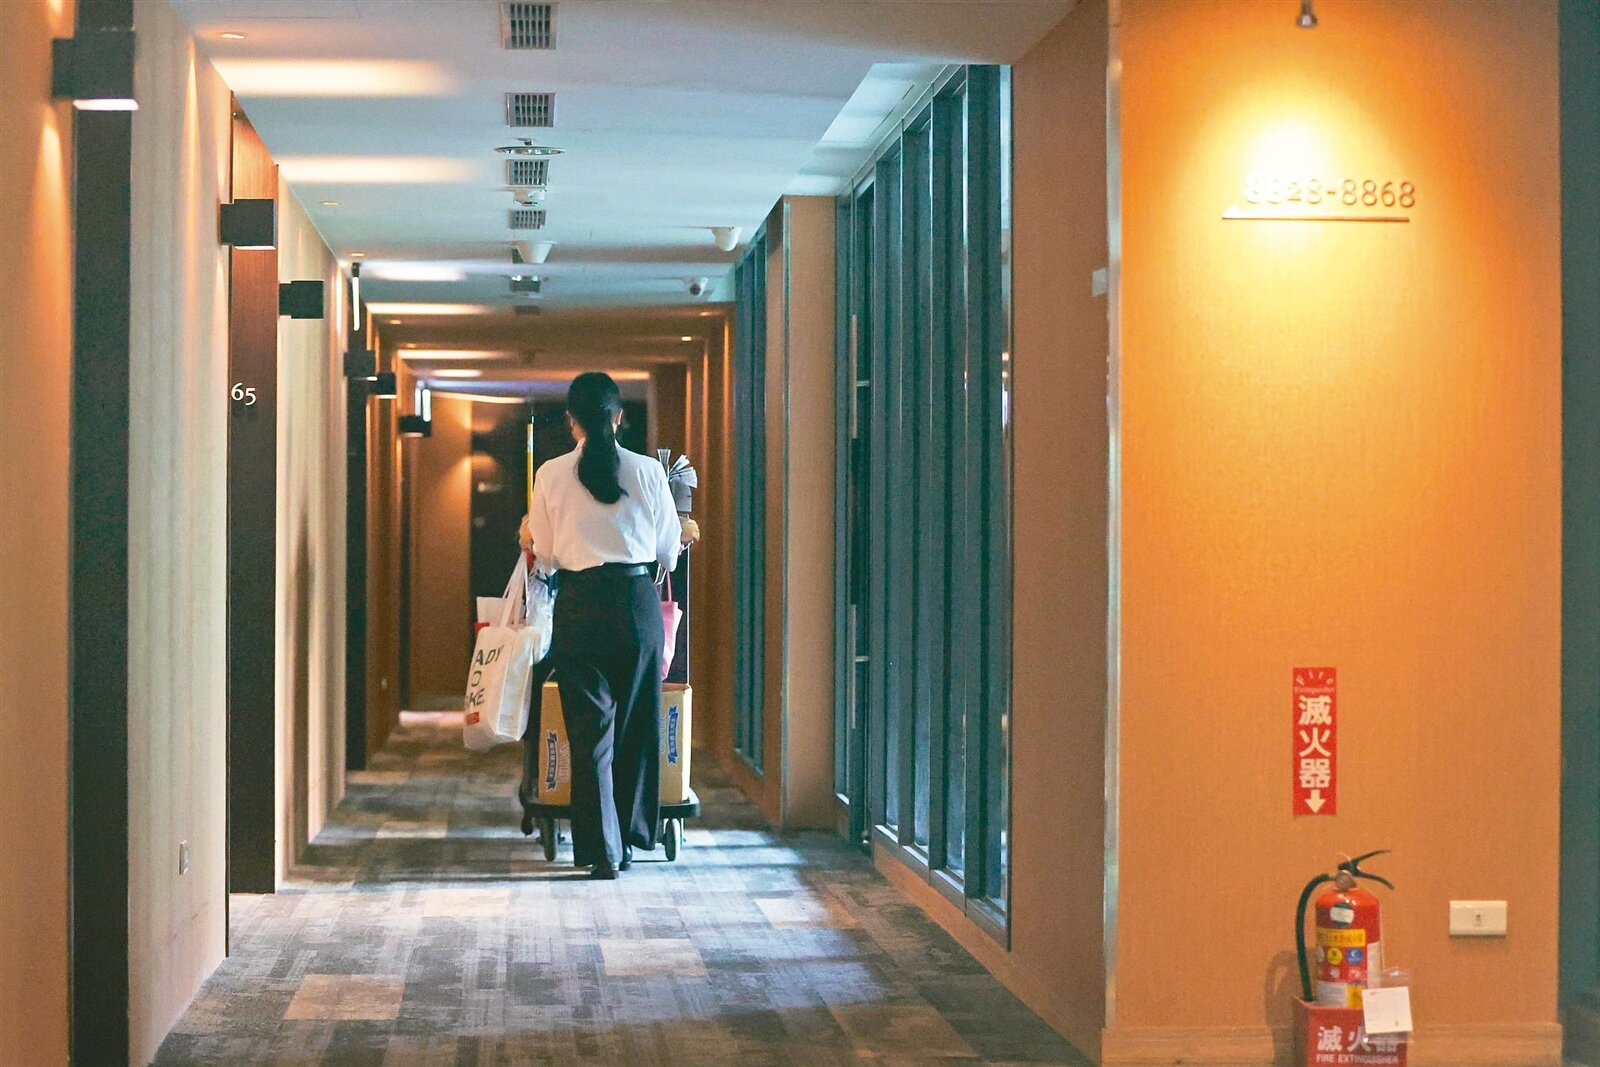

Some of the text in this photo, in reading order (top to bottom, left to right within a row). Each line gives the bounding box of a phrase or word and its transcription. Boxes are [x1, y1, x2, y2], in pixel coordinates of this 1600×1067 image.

[231, 382, 256, 406] 65
[1298, 695, 1332, 788] 滅火器
[1316, 1054, 1334, 1063] FIRE
